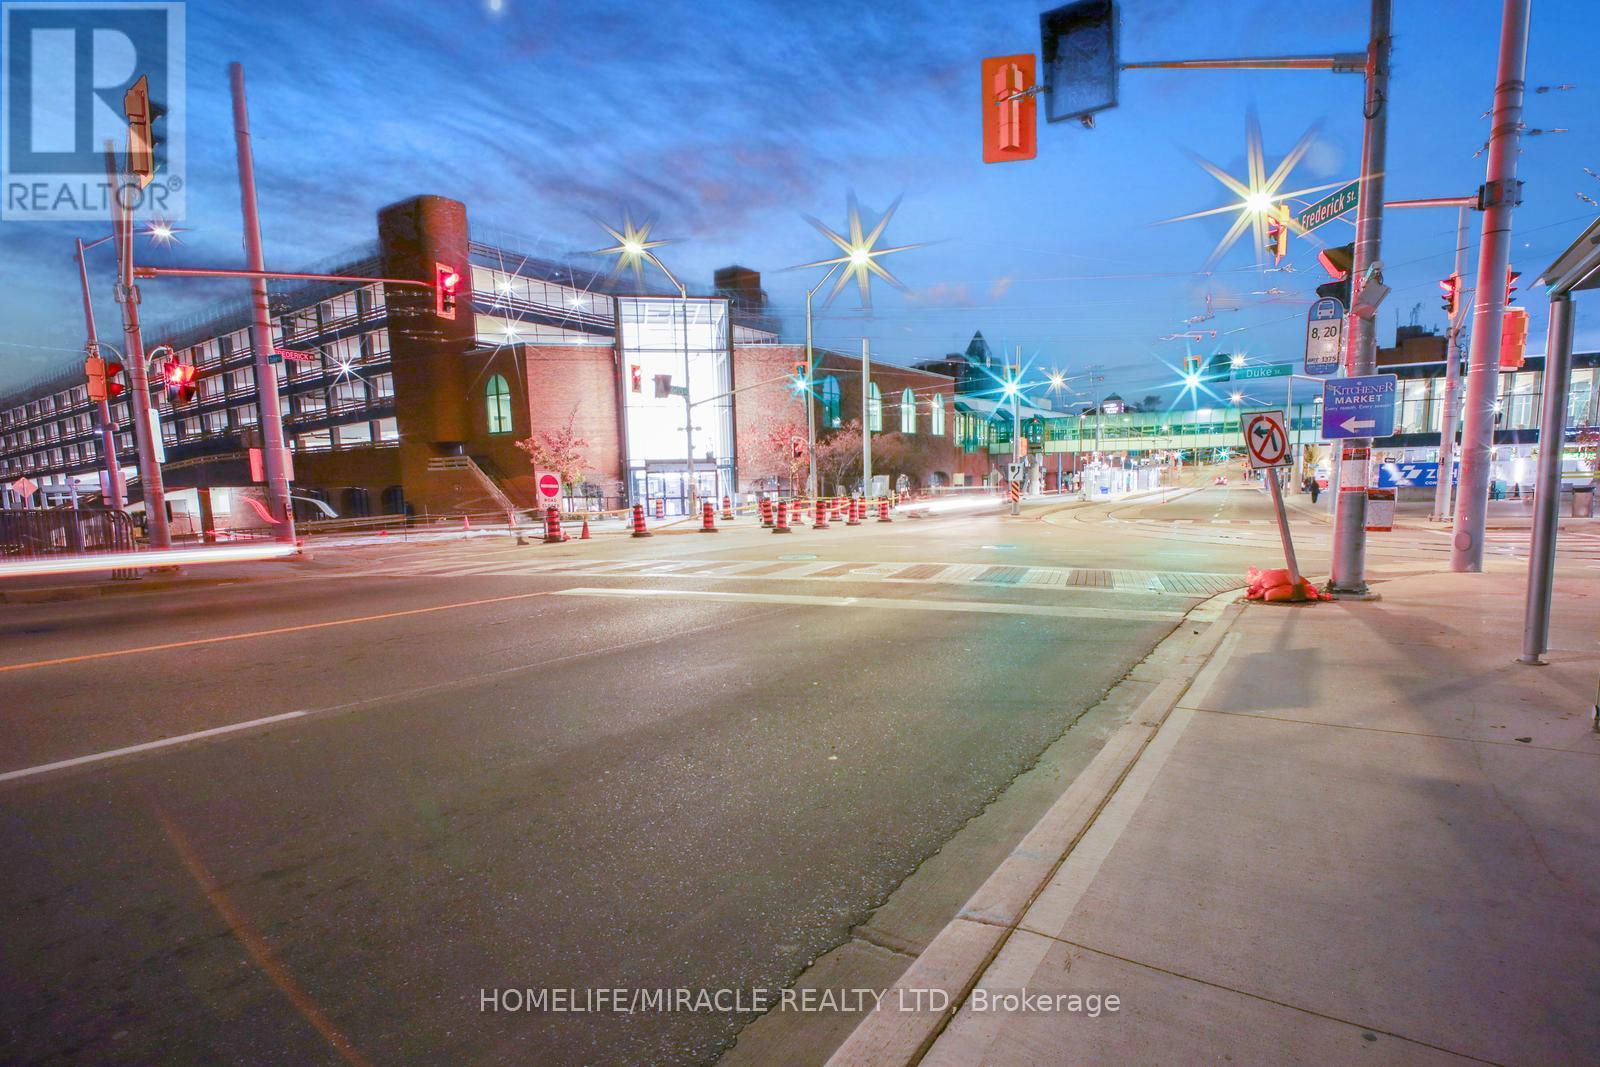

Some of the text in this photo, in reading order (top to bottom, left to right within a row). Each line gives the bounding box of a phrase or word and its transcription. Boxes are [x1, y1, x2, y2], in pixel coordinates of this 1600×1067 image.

[1301, 193, 1345, 230] Frederick
[1323, 326, 1337, 338] 20
[1246, 367, 1272, 378] Duke
[1333, 381, 1394, 396] KITCHENER
[1335, 394, 1382, 405] MARKET
